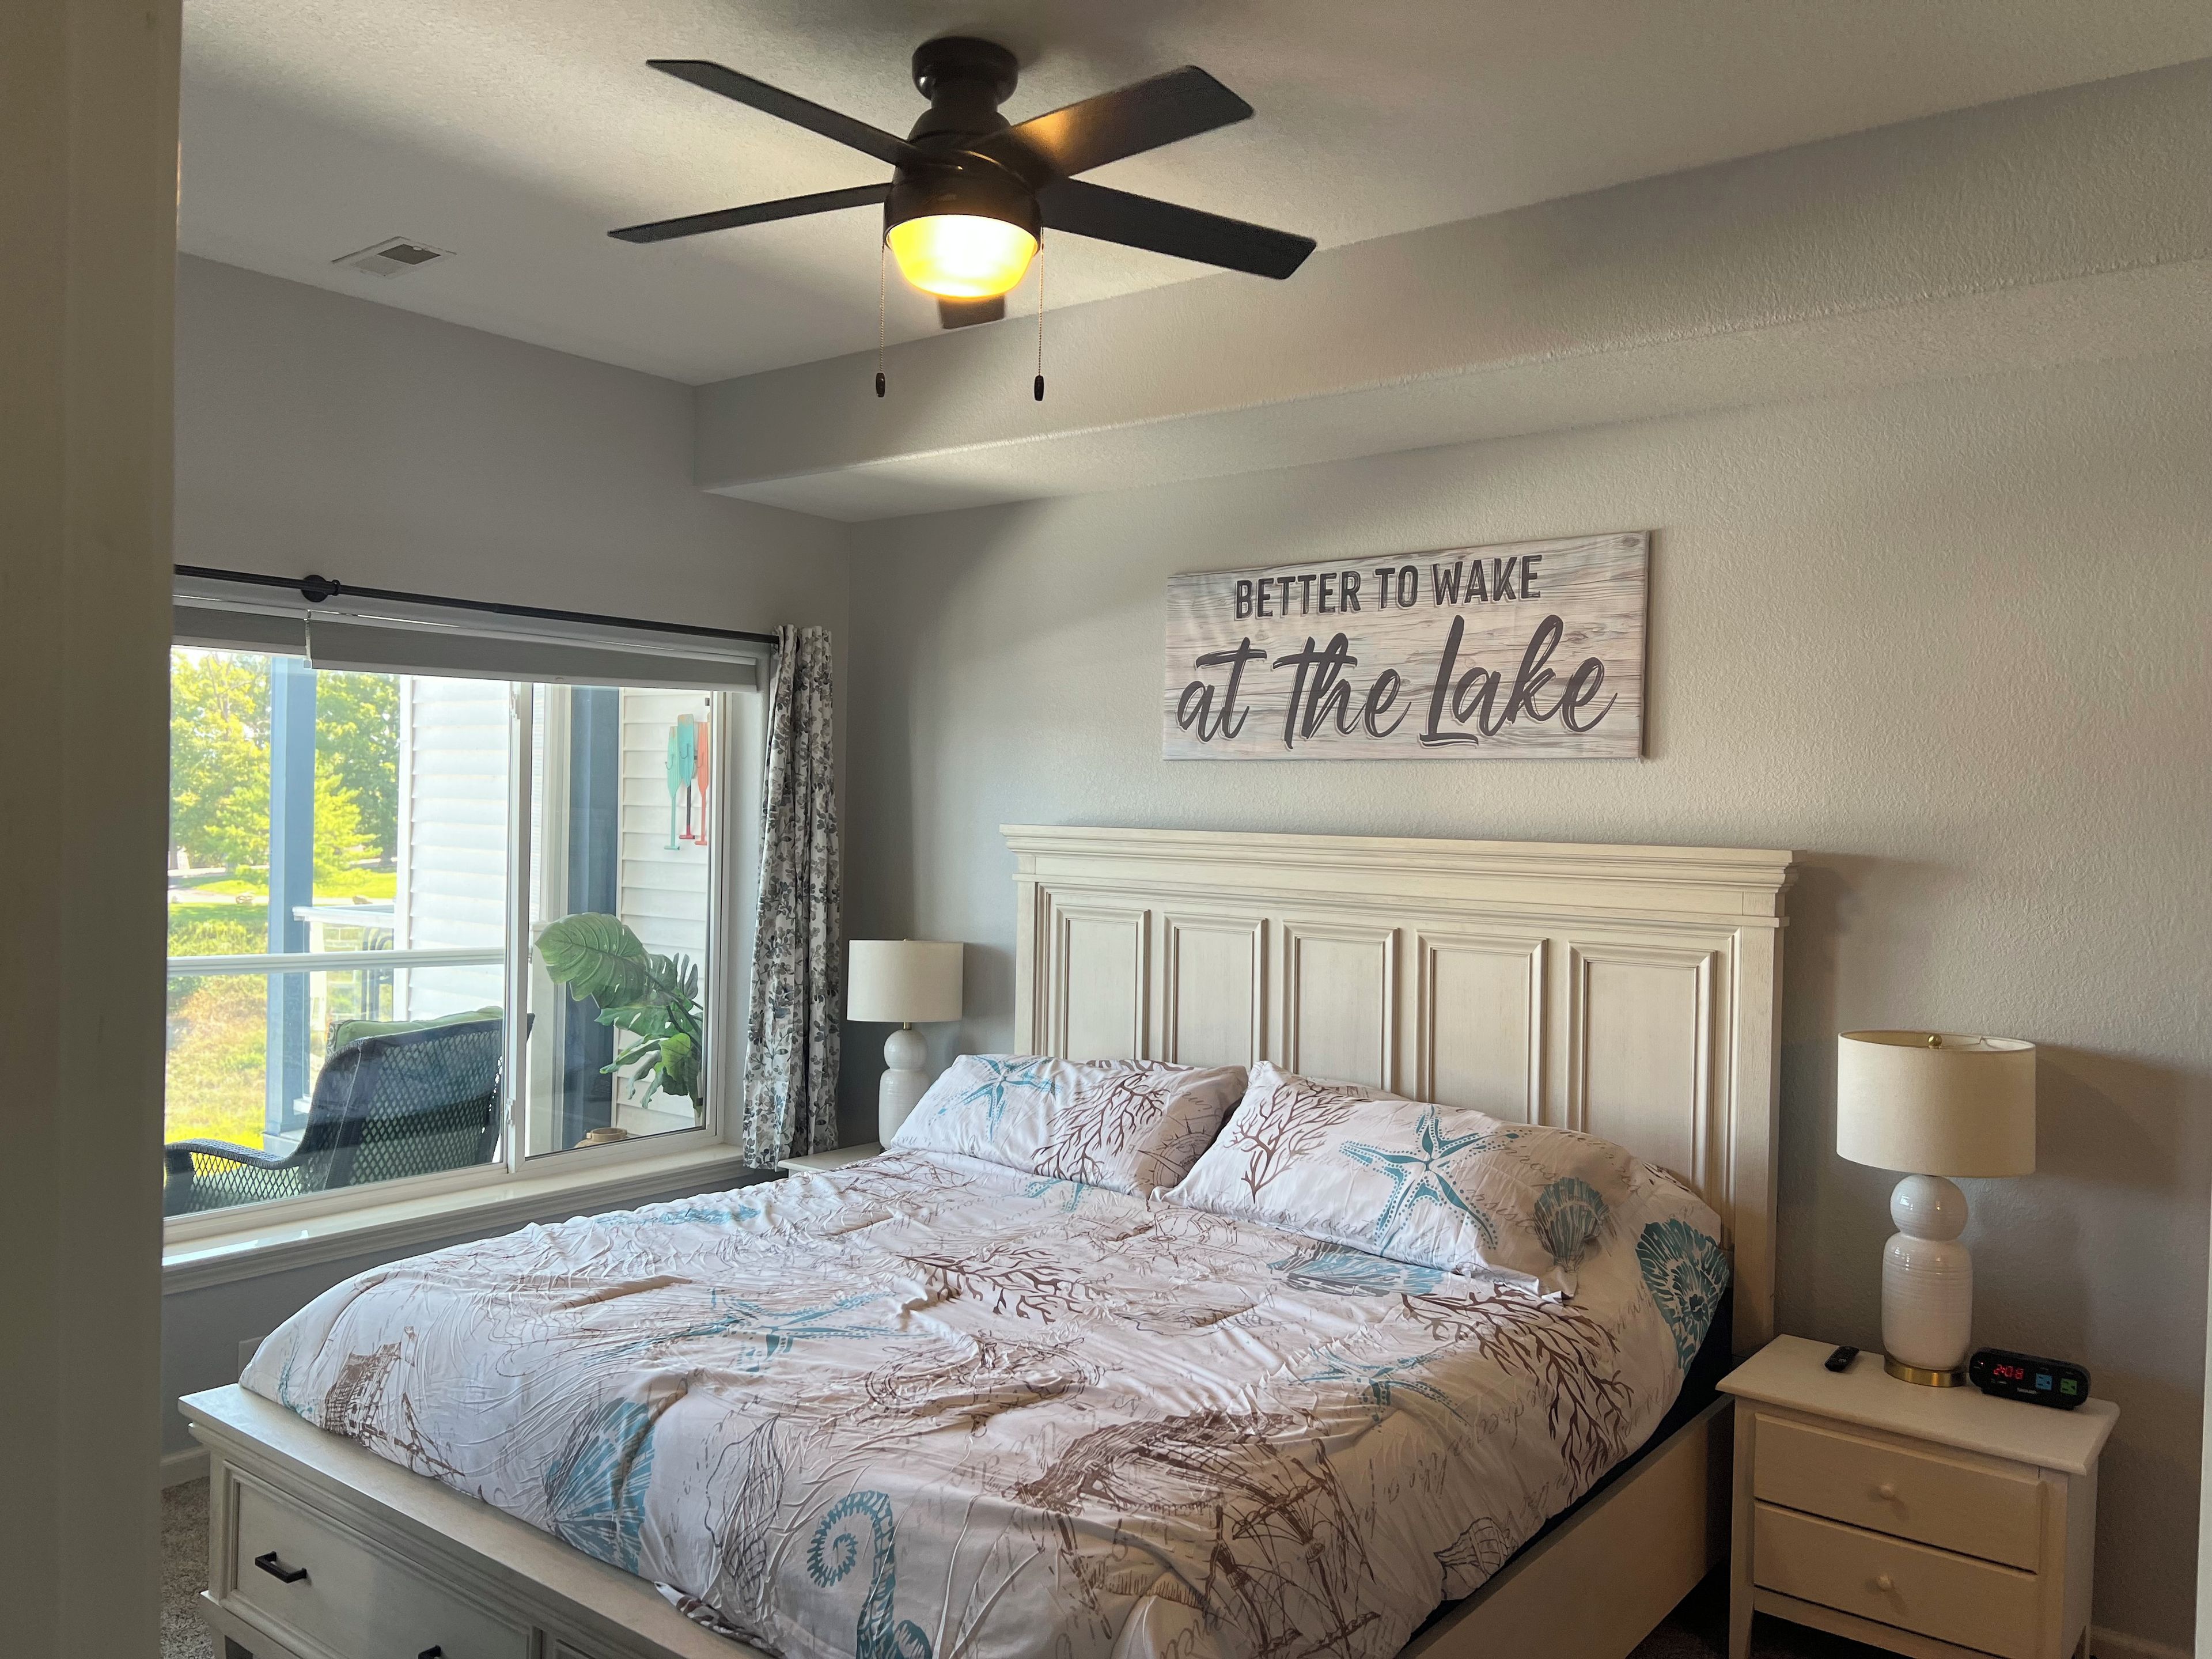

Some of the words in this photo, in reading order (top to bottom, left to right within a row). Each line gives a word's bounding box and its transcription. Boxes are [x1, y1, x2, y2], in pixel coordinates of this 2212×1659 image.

[1236, 570, 1362, 620] BETTER
[1374, 565, 1419, 609] TO
[1431, 554, 1543, 606] WAKE
[1176, 636, 1268, 743] at
[1272, 632, 1412, 750] the
[1419, 613, 1619, 748] Lake
[1993, 1363, 2025, 1380] 2:08
